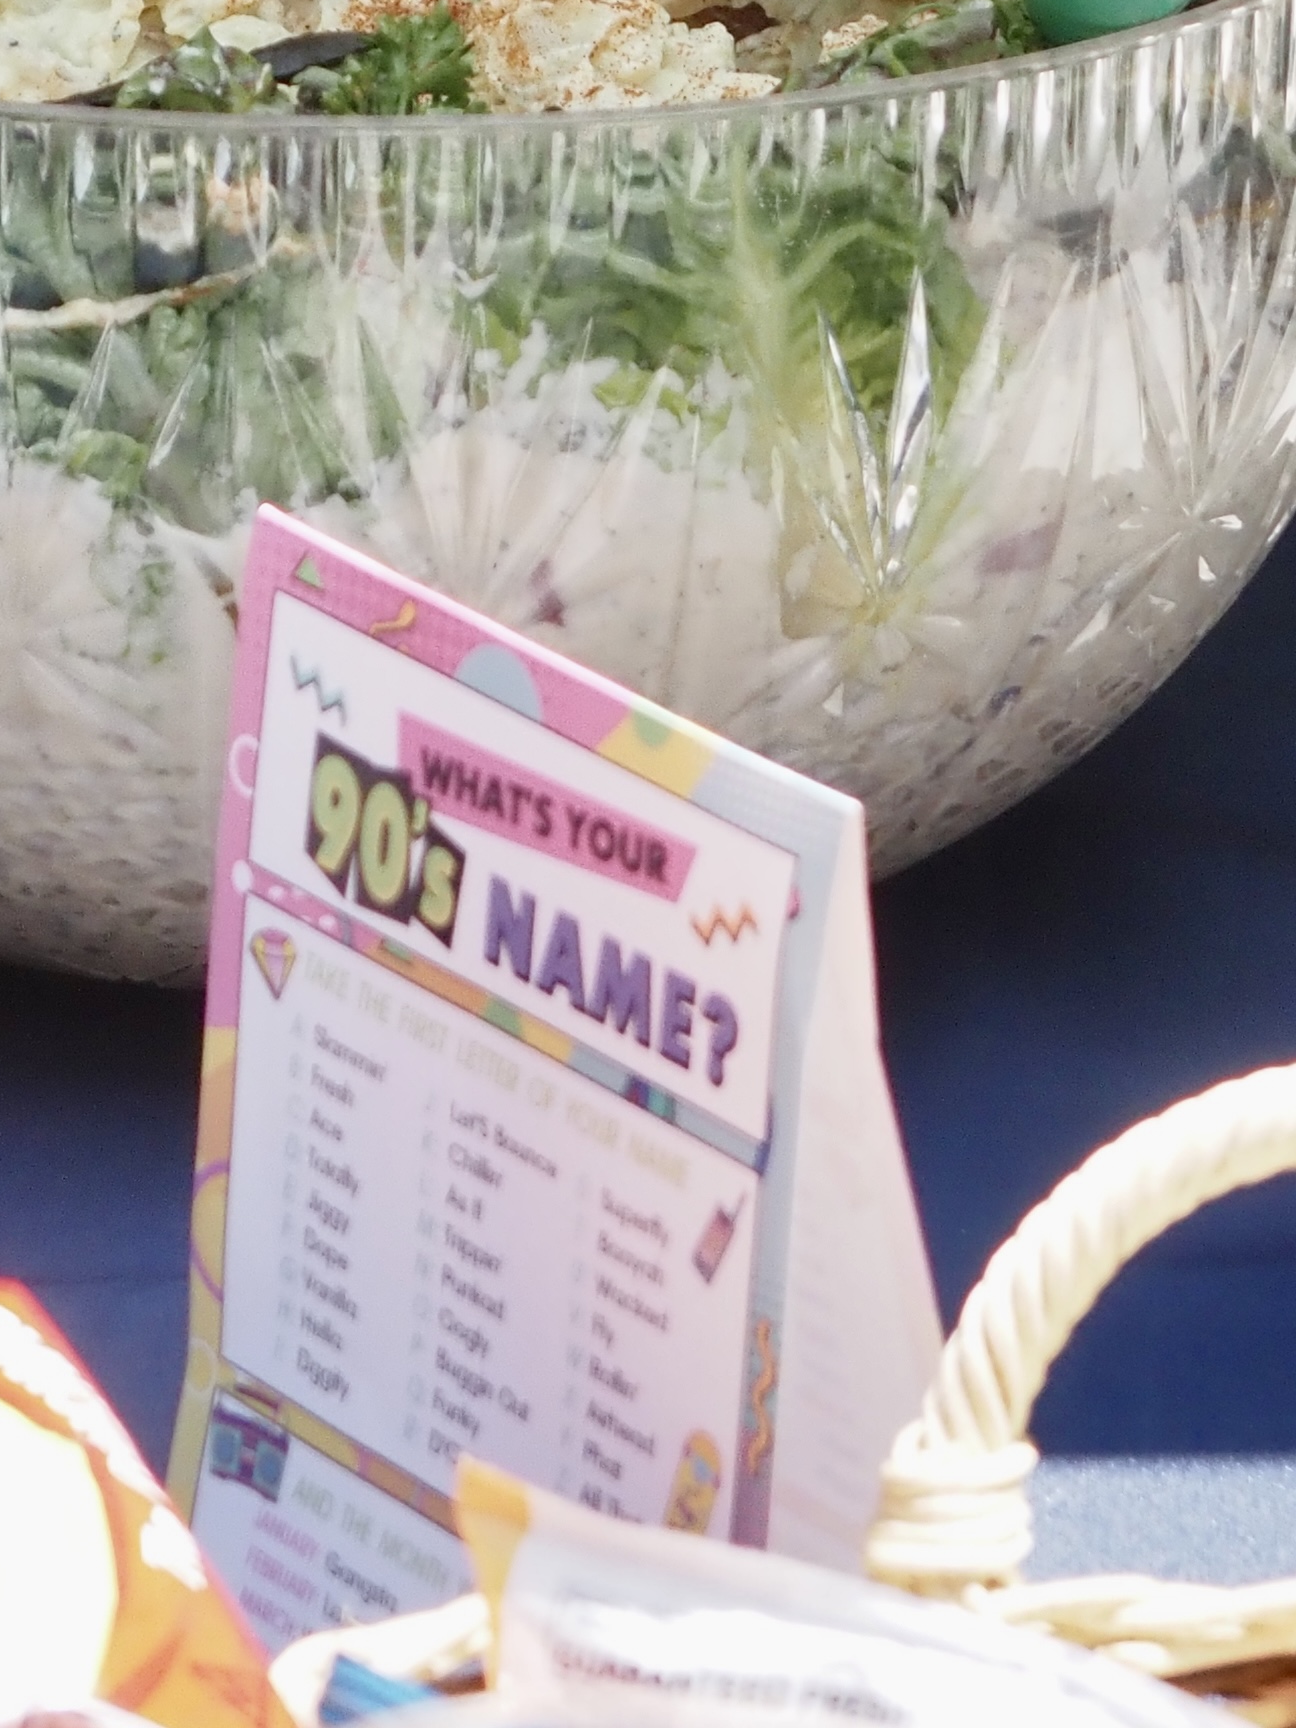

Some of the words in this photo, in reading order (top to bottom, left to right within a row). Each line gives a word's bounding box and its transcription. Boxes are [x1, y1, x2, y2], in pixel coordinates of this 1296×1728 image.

[310, 751, 460, 931] 90's
[419, 744, 555, 839] WHAT'S
[564, 803, 670, 885] YOUR
[483, 871, 740, 1088] NAME?
[358, 980, 390, 1023] THE
[399, 1003, 450, 1052] FIRST
[455, 1031, 520, 1092] LETTER
[311, 1062, 356, 1108] Fresh
[310, 1107, 343, 1142] Ace
[493, 1123, 558, 1179] Bounce
[308, 1143, 360, 1199] Totally
[445, 1182, 468, 1213] As
[303, 1224, 349, 1271] Dope
[301, 1267, 358, 1321] Vanilla
[591, 1311, 615, 1350] Fly
[432, 1386, 481, 1439] Funky
[498, 1385, 530, 1422] Out
[254, 1509, 322, 1563] JANUARY
[245, 1544, 320, 1602] FEBRUARY
